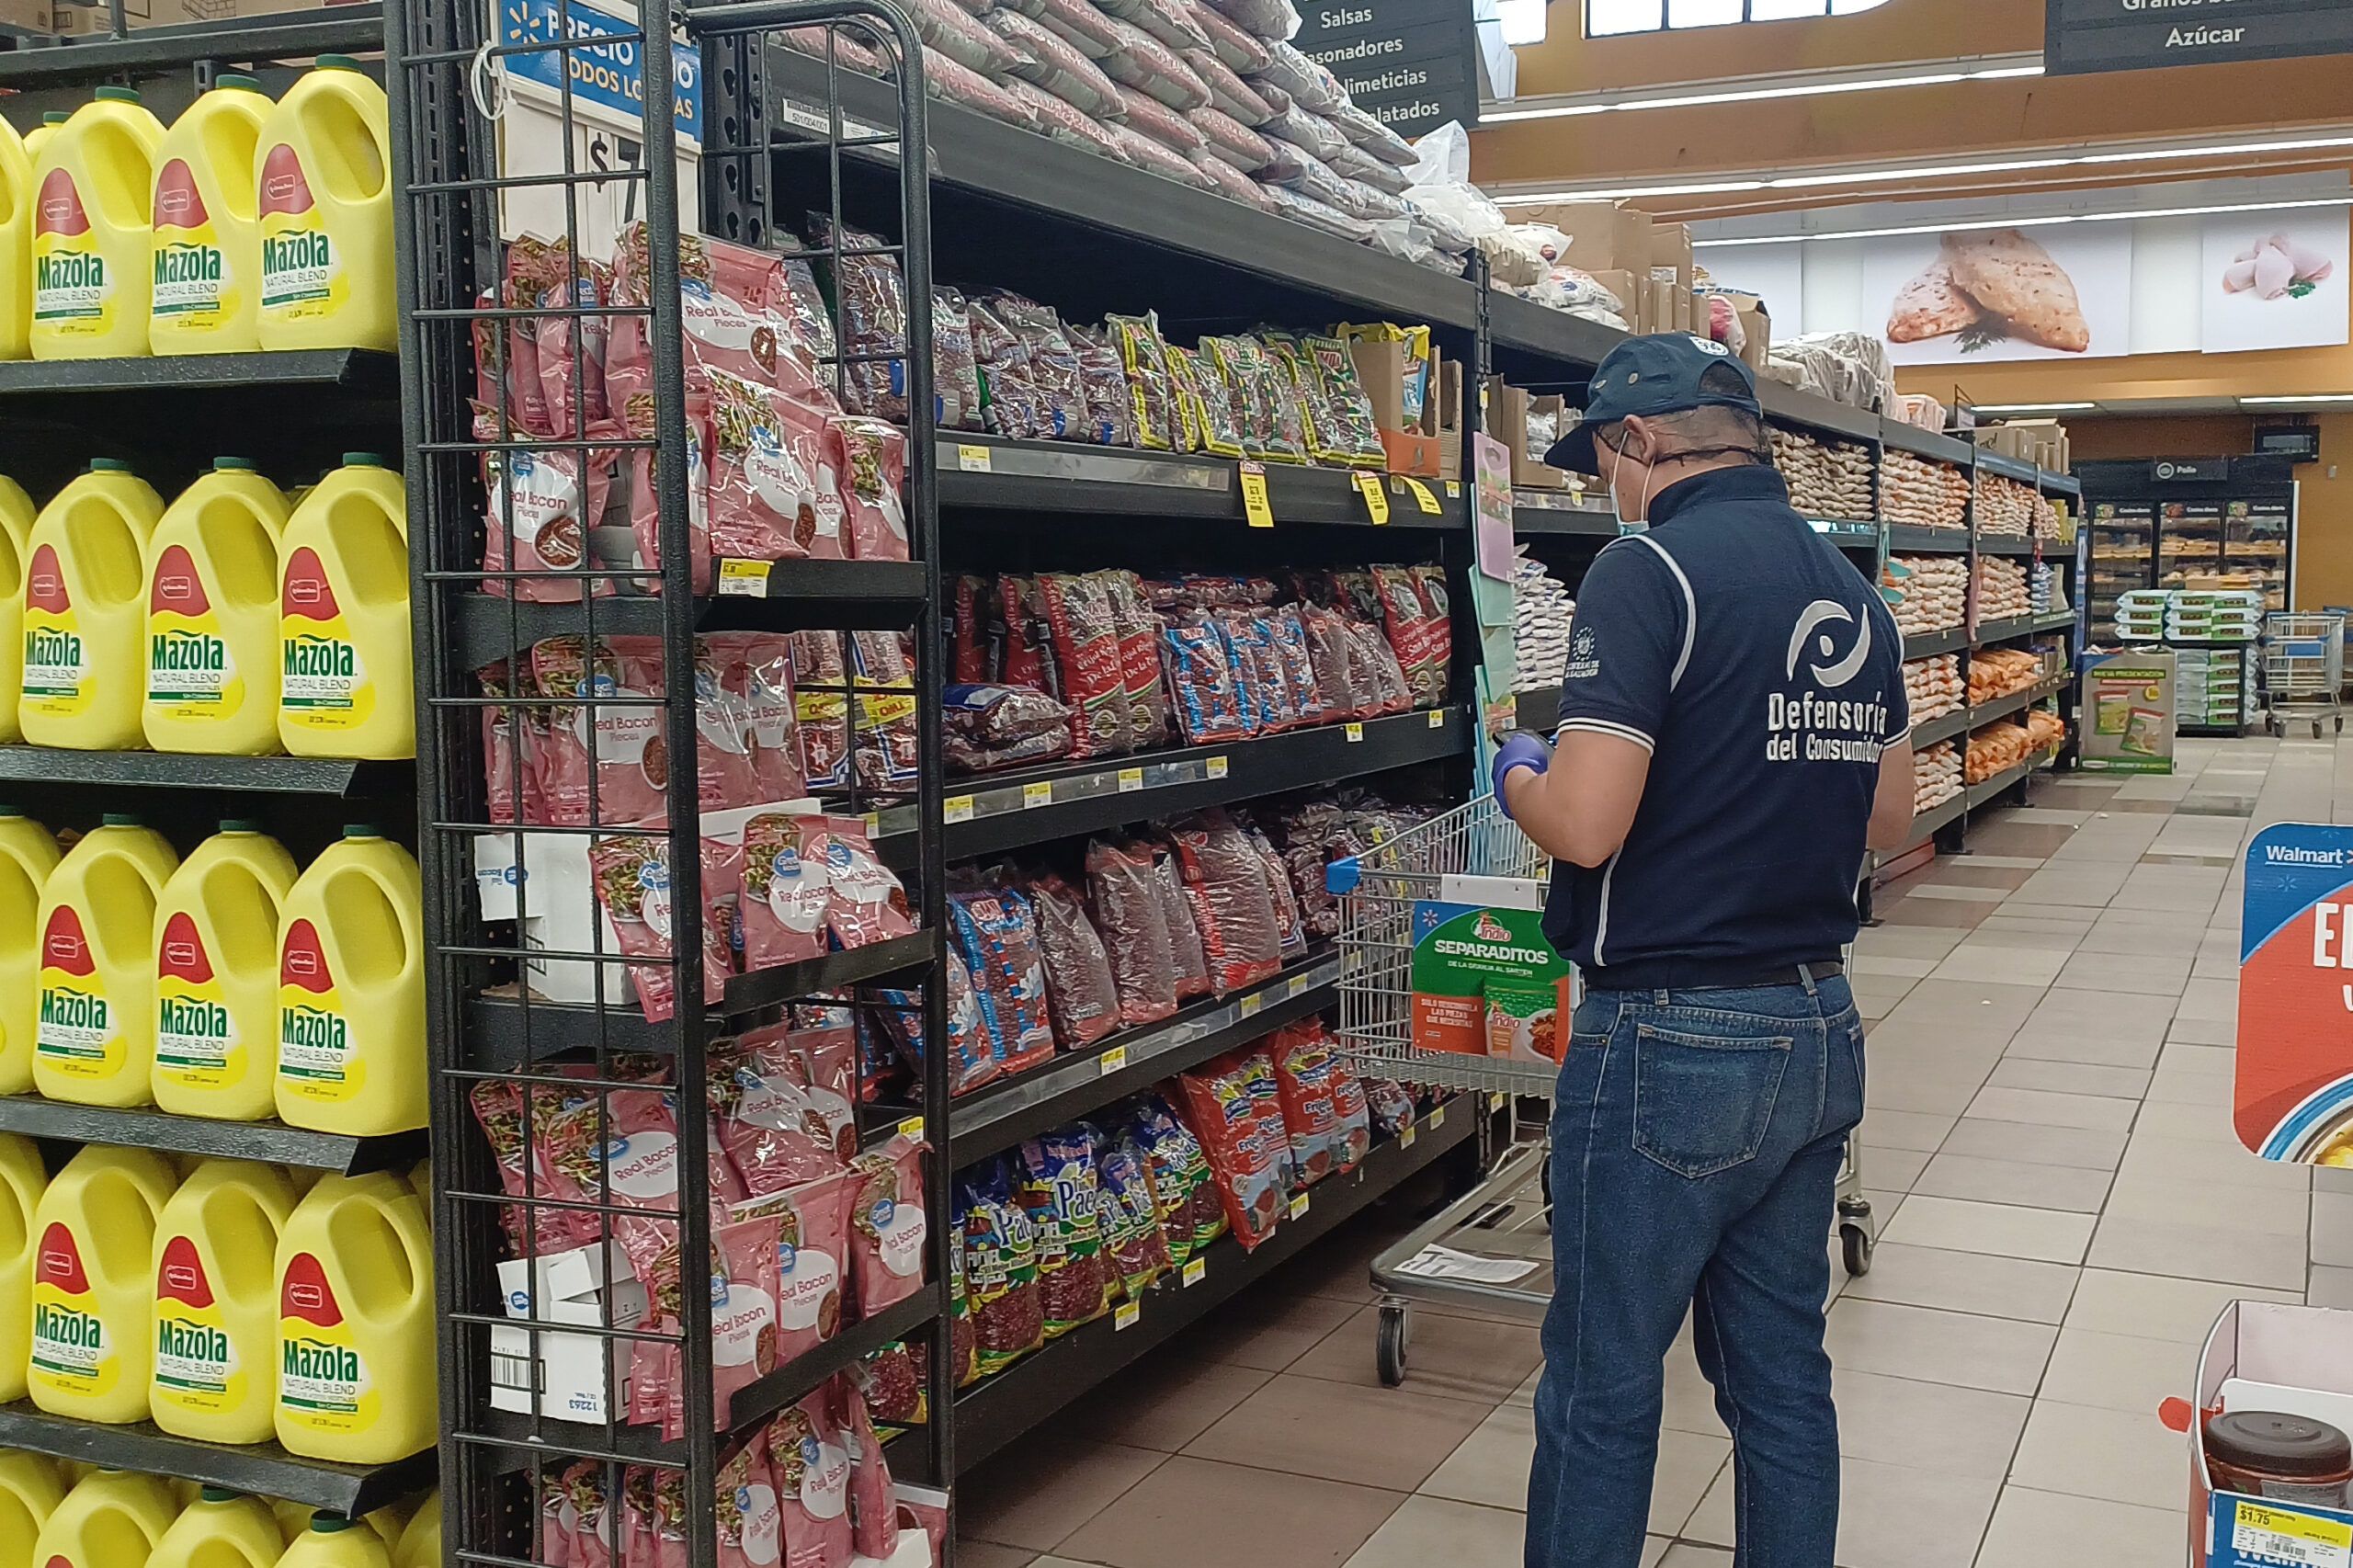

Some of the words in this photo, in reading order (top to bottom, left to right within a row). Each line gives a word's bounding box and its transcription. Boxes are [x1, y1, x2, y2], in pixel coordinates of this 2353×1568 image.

[1321, 8, 1372, 28] Salsas
[2165, 26, 2245, 47] Azúcar
[1300, 37, 1404, 65] asonadores
[569, 56, 620, 93] ODOS
[1345, 69, 1427, 95] limeticias
[154, 245, 221, 286] Mazola
[263, 231, 329, 276] Mazola
[39, 256, 103, 291] Mazola
[297, 270, 327, 283] BLEND
[72, 290, 101, 301] BLEND
[188, 283, 219, 294] BLEND
[26, 631, 81, 667] Mazola
[152, 634, 224, 671] Mazola
[284, 639, 354, 676] Mazola
[51, 669, 78, 680] BLEND
[189, 673, 222, 685] BLEND
[318, 679, 351, 691] BLEND
[617, 716, 658, 729] Bacon
[1768, 690, 1888, 735] Defensoría
[1767, 732, 1798, 762] del
[1806, 733, 1883, 764] Consumidor
[2266, 845, 2344, 865] Walmart
[1434, 939, 1549, 965] SEPARADITOS
[40, 988, 108, 1029] Mazola
[160, 997, 227, 1038] Mazola
[74, 1029, 104, 1042] BLEND
[282, 1007, 346, 1050] Mazola
[194, 1039, 225, 1051] BLEND
[314, 1051, 344, 1063] BLEND
[613, 1159, 643, 1182] Real
[780, 1286, 797, 1301] eal
[797, 1270, 833, 1290] Bacon
[35, 1302, 101, 1349] Mazola
[712, 1314, 733, 1336] eal
[159, 1319, 228, 1363] Mazola
[68, 1348, 97, 1361] BLEND
[283, 1338, 358, 1382] Mazola
[193, 1363, 225, 1376] BLEND
[322, 1382, 356, 1395] BLEND
[2239, 1509, 2270, 1526] $1.75
